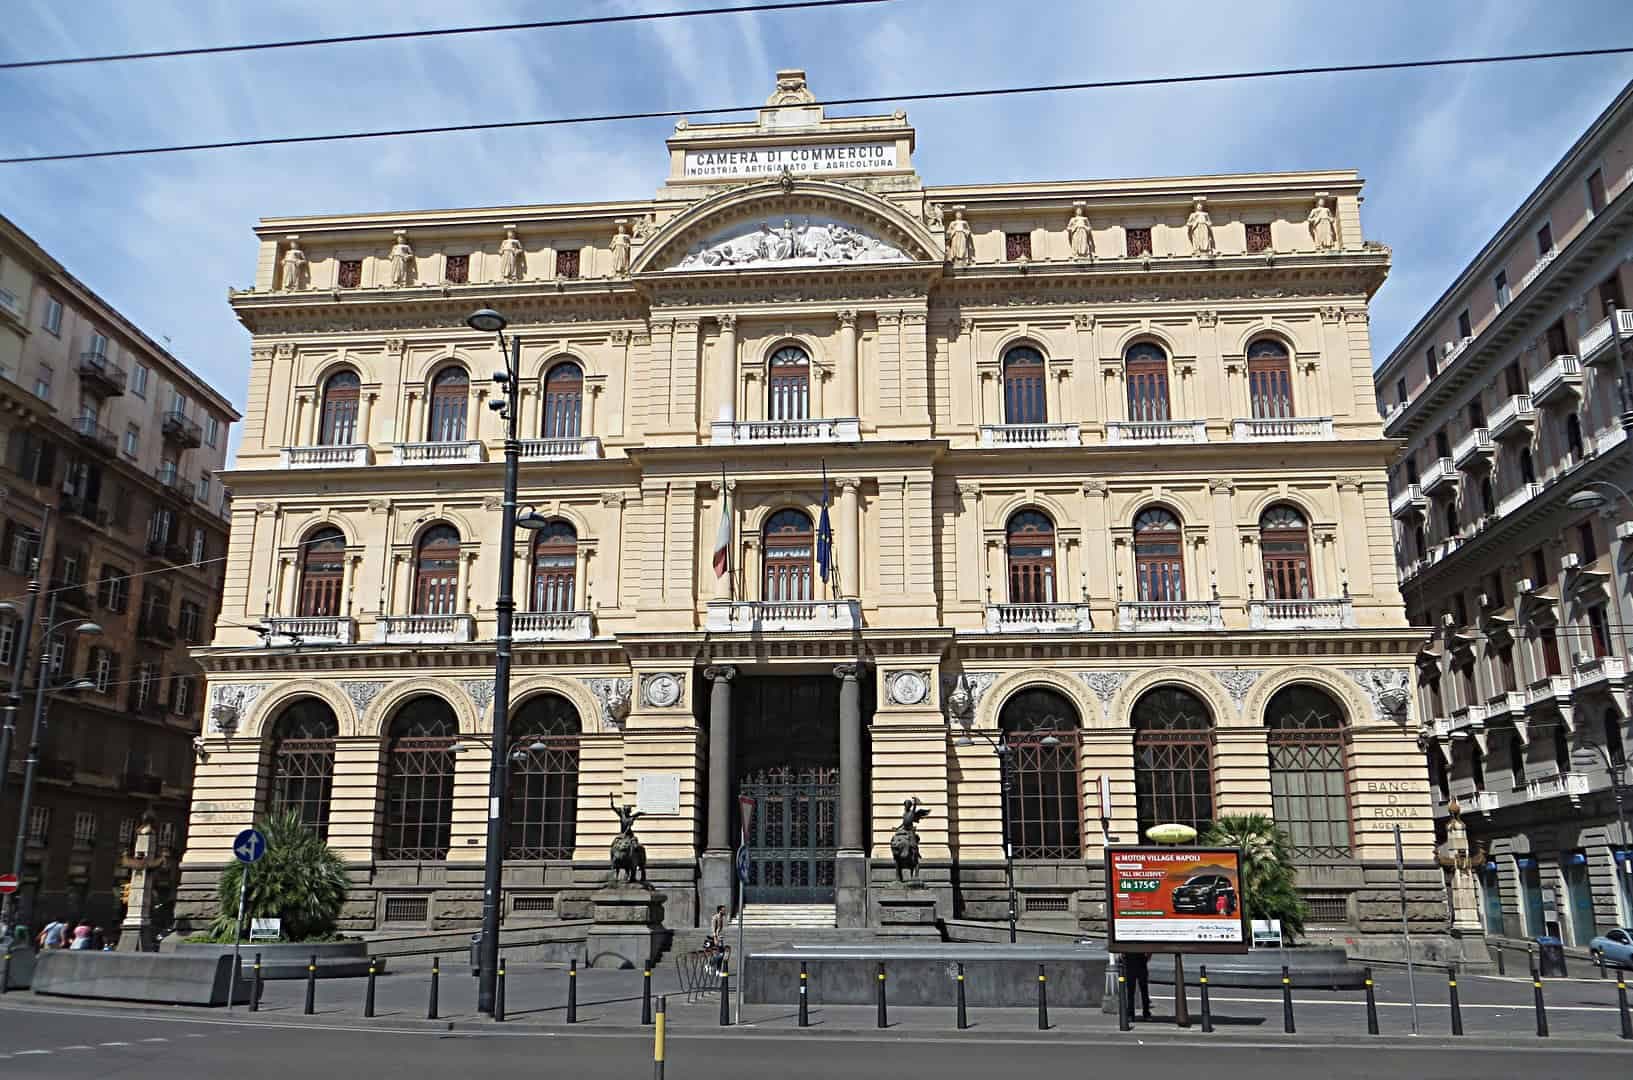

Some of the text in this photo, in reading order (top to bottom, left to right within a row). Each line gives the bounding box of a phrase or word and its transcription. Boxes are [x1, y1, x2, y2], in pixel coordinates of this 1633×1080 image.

[697, 145, 884, 166] CAMERA DI COMMERCIO
[687, 159, 893, 176] INDUSTRIA ARTIGIANATO E AGRICOLTURA
[1374, 807, 1418, 817] ROMA
[1121, 880, 1131, 888] da
